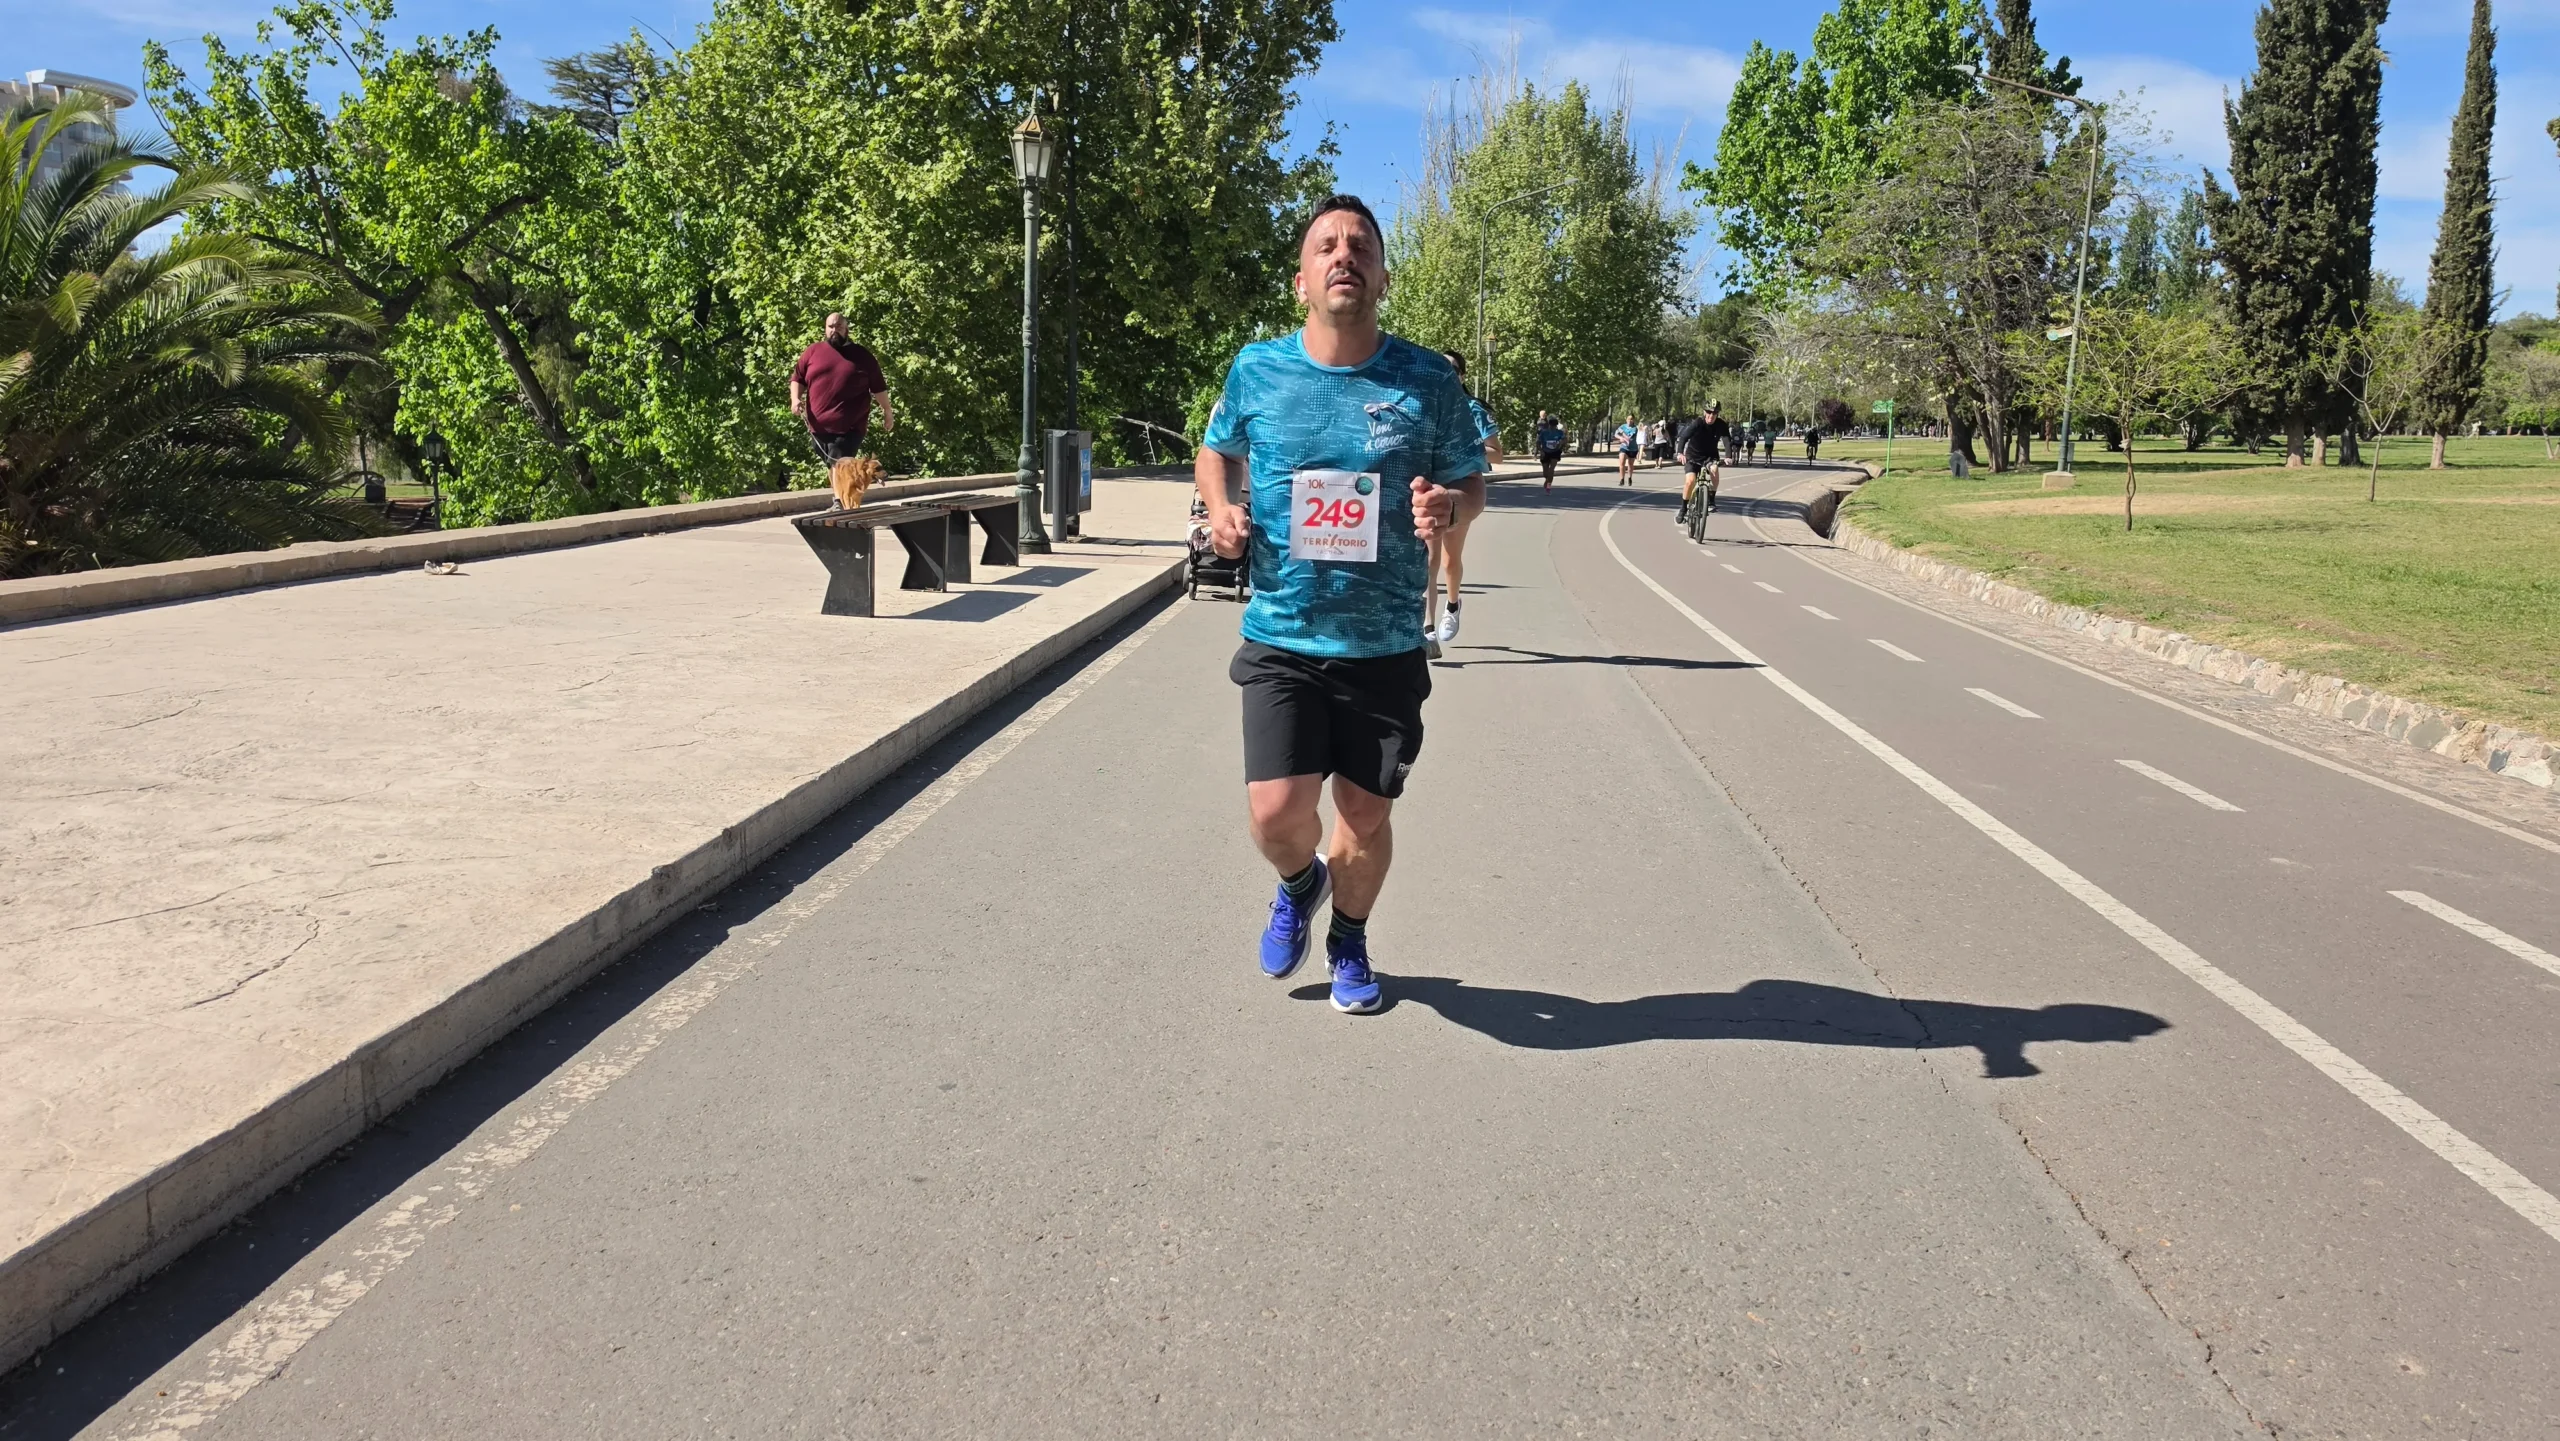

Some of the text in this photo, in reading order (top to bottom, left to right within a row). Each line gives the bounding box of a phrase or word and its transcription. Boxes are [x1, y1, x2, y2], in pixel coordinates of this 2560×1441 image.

[1308, 479, 1325, 489] 10k
[1301, 497, 1366, 528] 249
[1302, 534, 1368, 547] TERRITORIO
